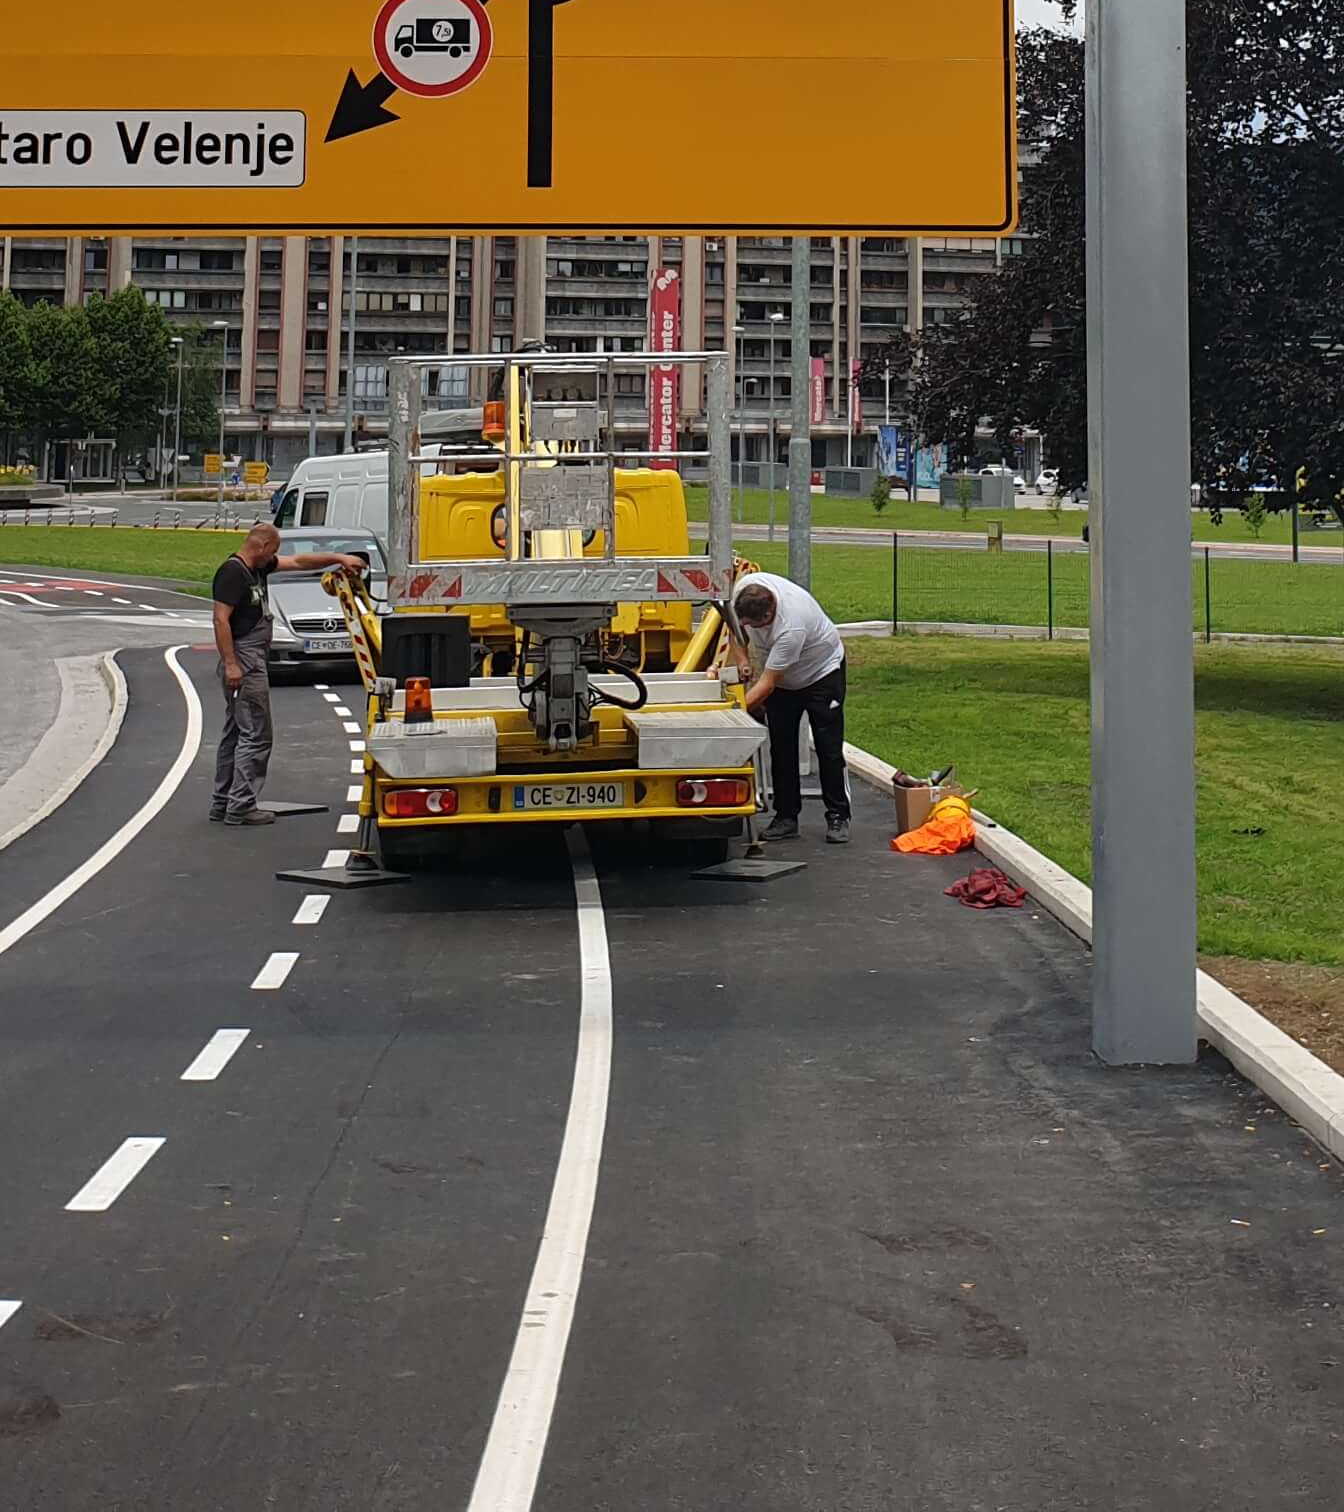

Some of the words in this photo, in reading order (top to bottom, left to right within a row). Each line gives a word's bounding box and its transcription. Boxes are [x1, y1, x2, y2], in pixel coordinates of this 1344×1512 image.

[116, 121, 294, 177] Velenje
[465, 568, 656, 595] MULTITEL
[530, 787, 553, 806] CE
[566, 785, 617, 804] ZI-940
